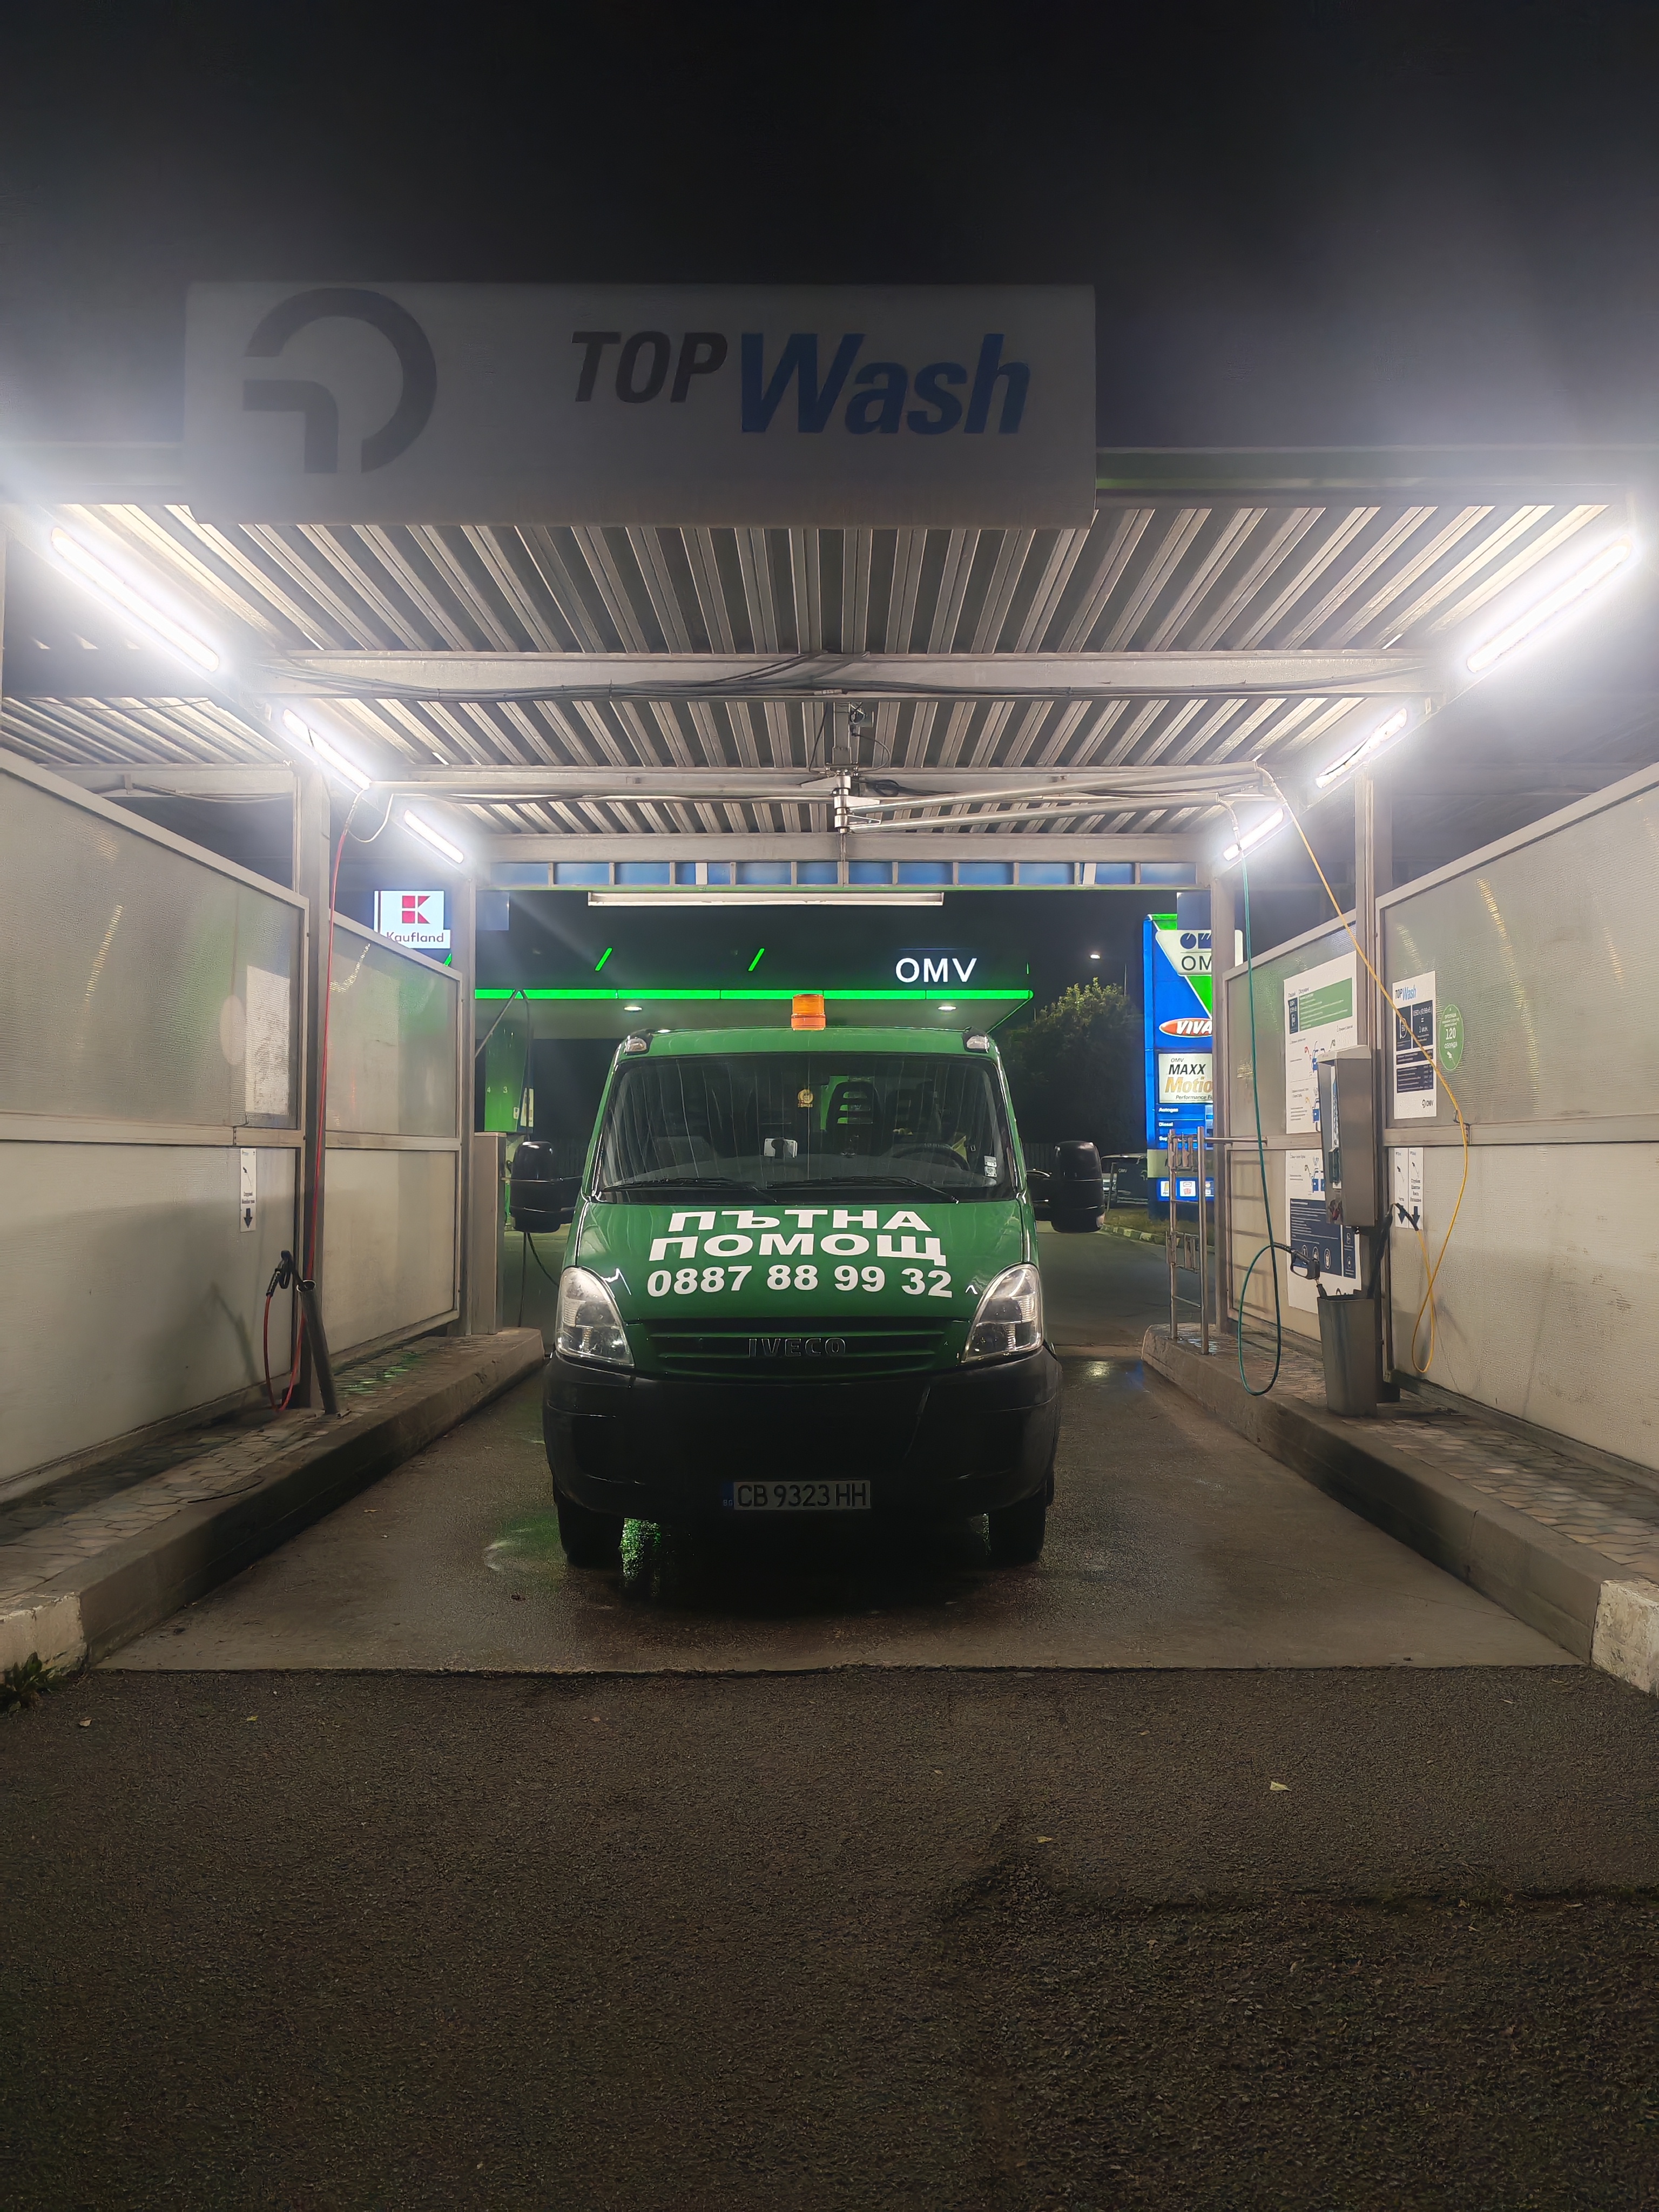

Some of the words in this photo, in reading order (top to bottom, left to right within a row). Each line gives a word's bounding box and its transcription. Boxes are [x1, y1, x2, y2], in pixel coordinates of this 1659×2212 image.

[571, 331, 728, 403] TOP
[740, 333, 1031, 434] Wash
[895, 957, 977, 983] OMV
[1181, 955, 1212, 971] OM
[1402, 984, 1417, 1001] Wash
[1446, 1027, 1456, 1040] 120
[1168, 1064, 1206, 1075] MAXX
[1165, 1076, 1213, 1093] Motio
[667, 1209, 933, 1232] ПЪТНА
[649, 1233, 947, 1267] ПОМОЩ
[647, 1265, 752, 1297] 0887
[767, 1265, 818, 1290] 88
[834, 1265, 886, 1292] 99
[901, 1268, 953, 1298] 32
[748, 1337, 846, 1358] IVECO
[774, 1484, 830, 1507] 9323
[835, 1483, 867, 1507] HH
